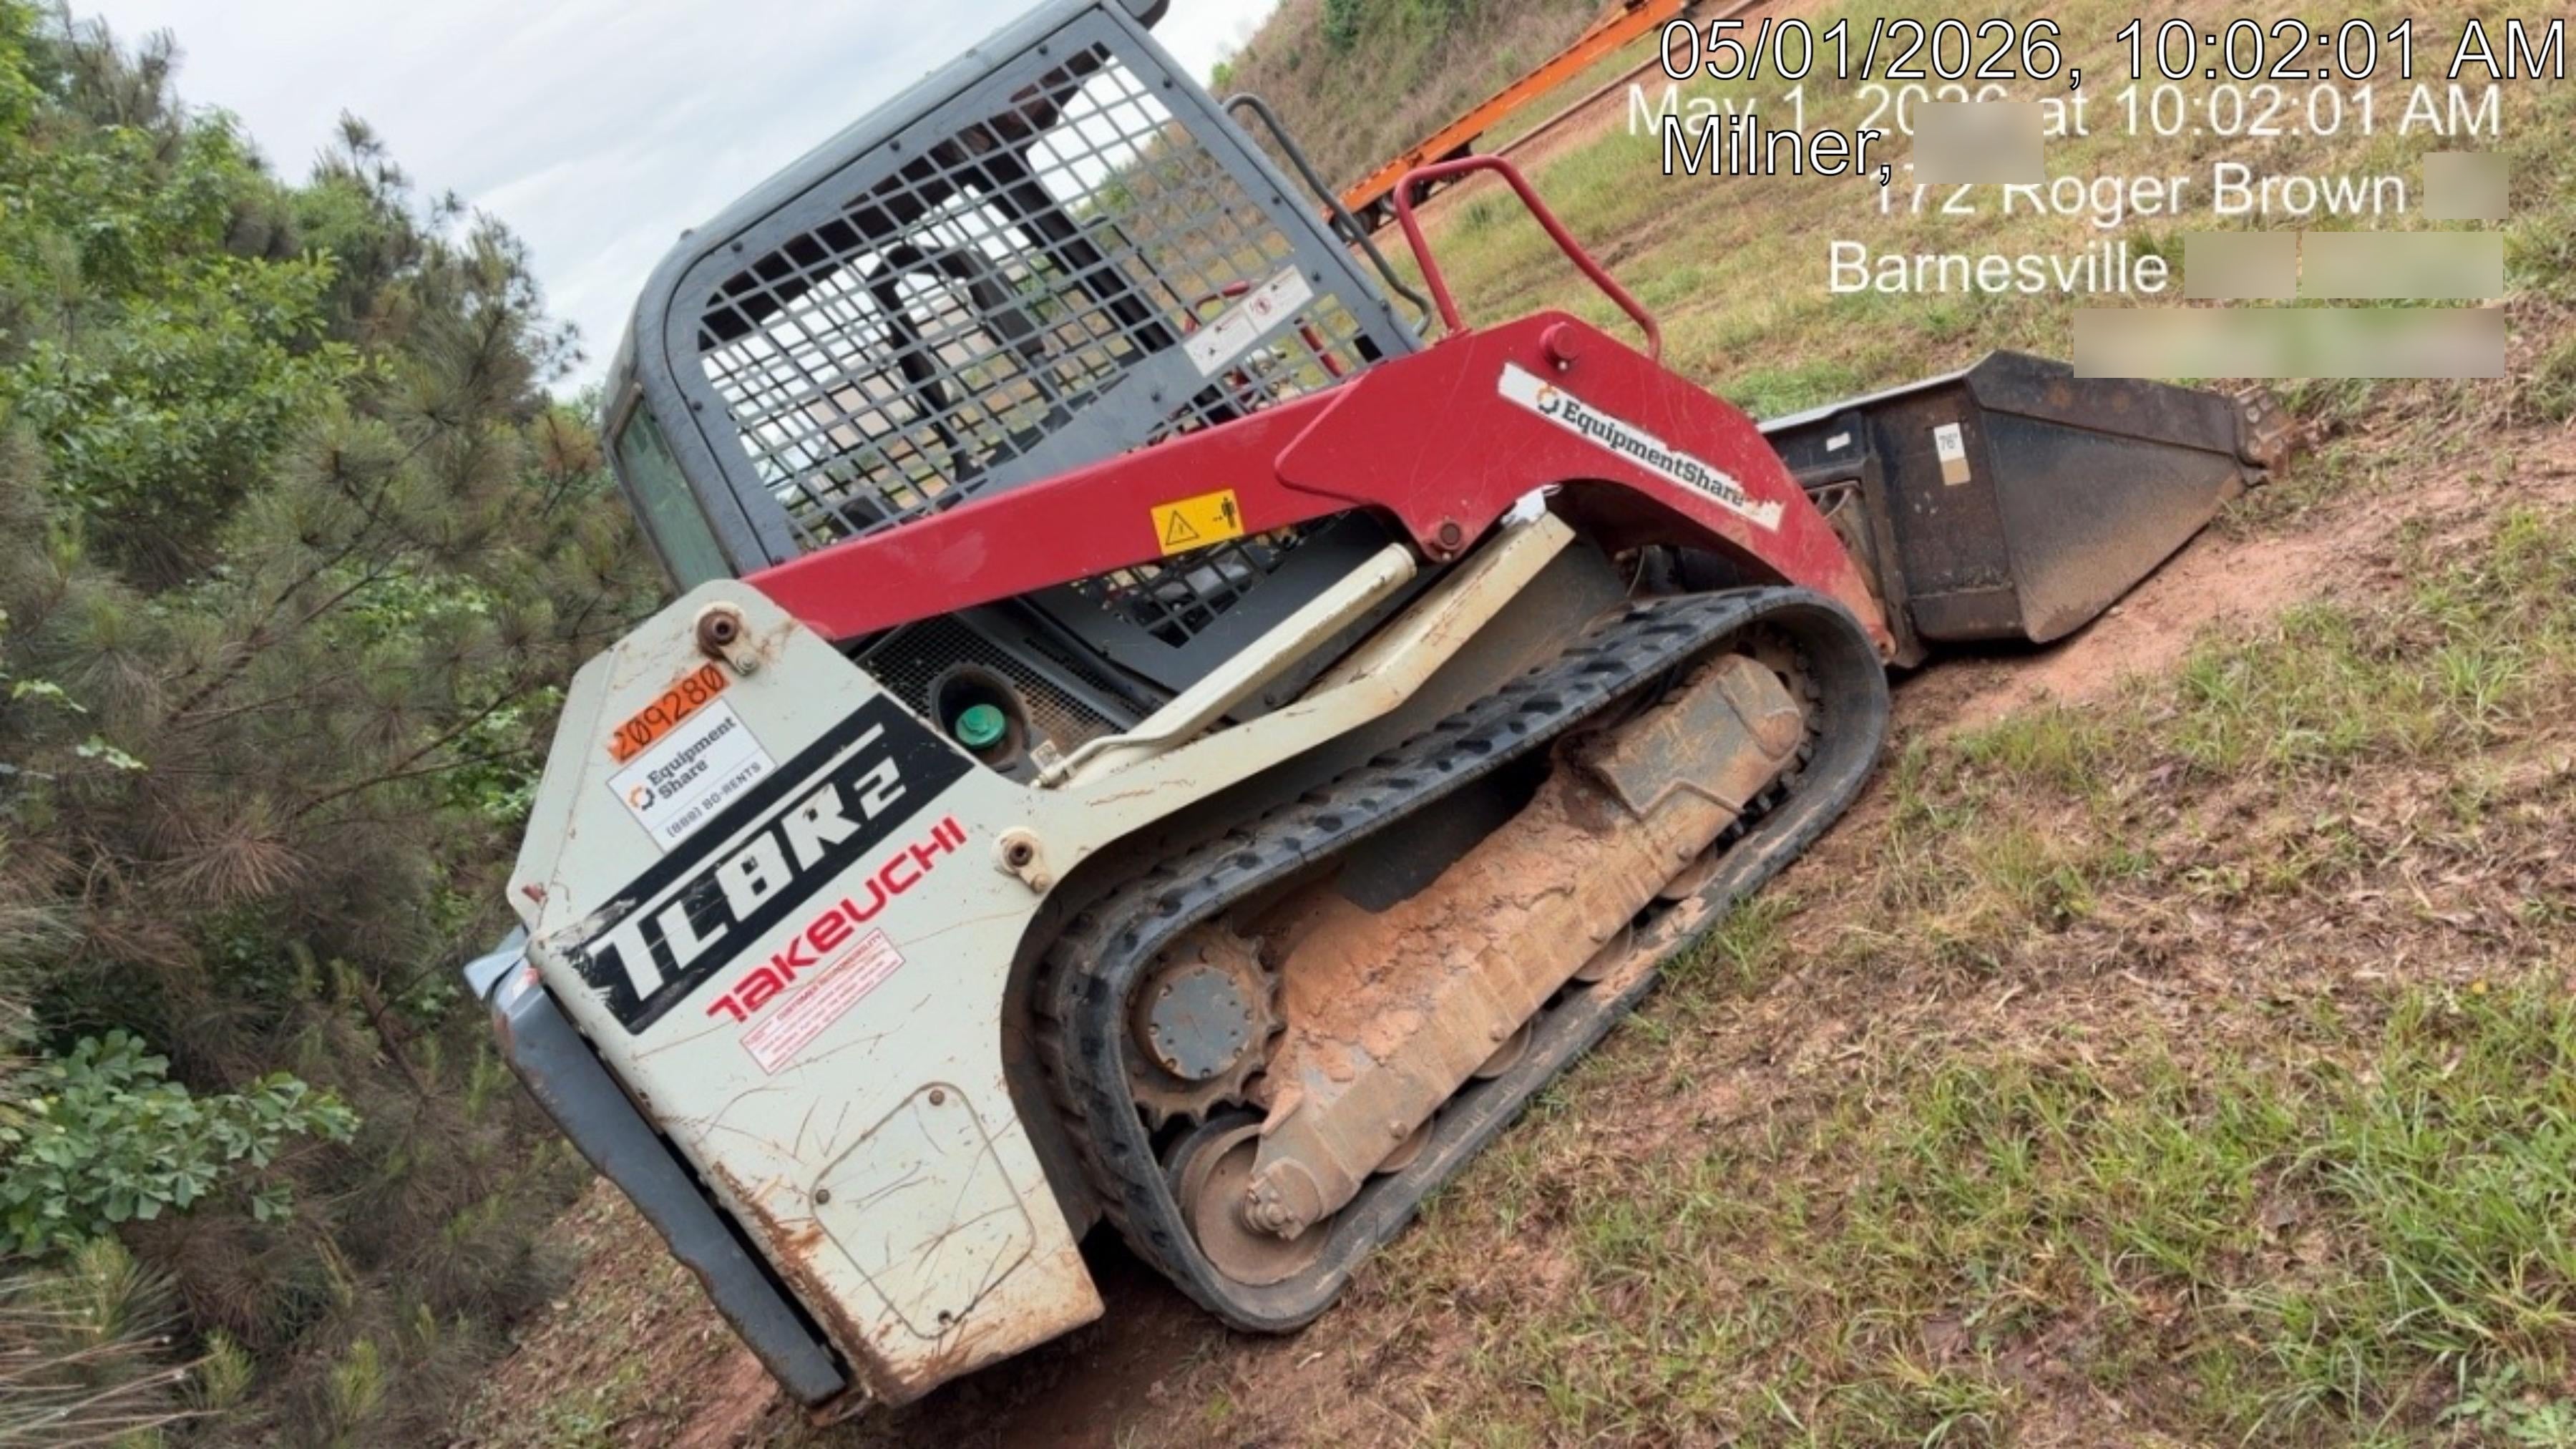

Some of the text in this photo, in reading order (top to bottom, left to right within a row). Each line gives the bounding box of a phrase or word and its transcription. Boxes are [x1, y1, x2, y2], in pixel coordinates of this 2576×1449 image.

[1562, 399, 1745, 507] EquipmentShare
[613, 665, 724, 761] 209280
[647, 716, 737, 786] Equipment
[658, 760, 710, 799] Share
[706, 816, 967, 1023] TAKEUCHI
